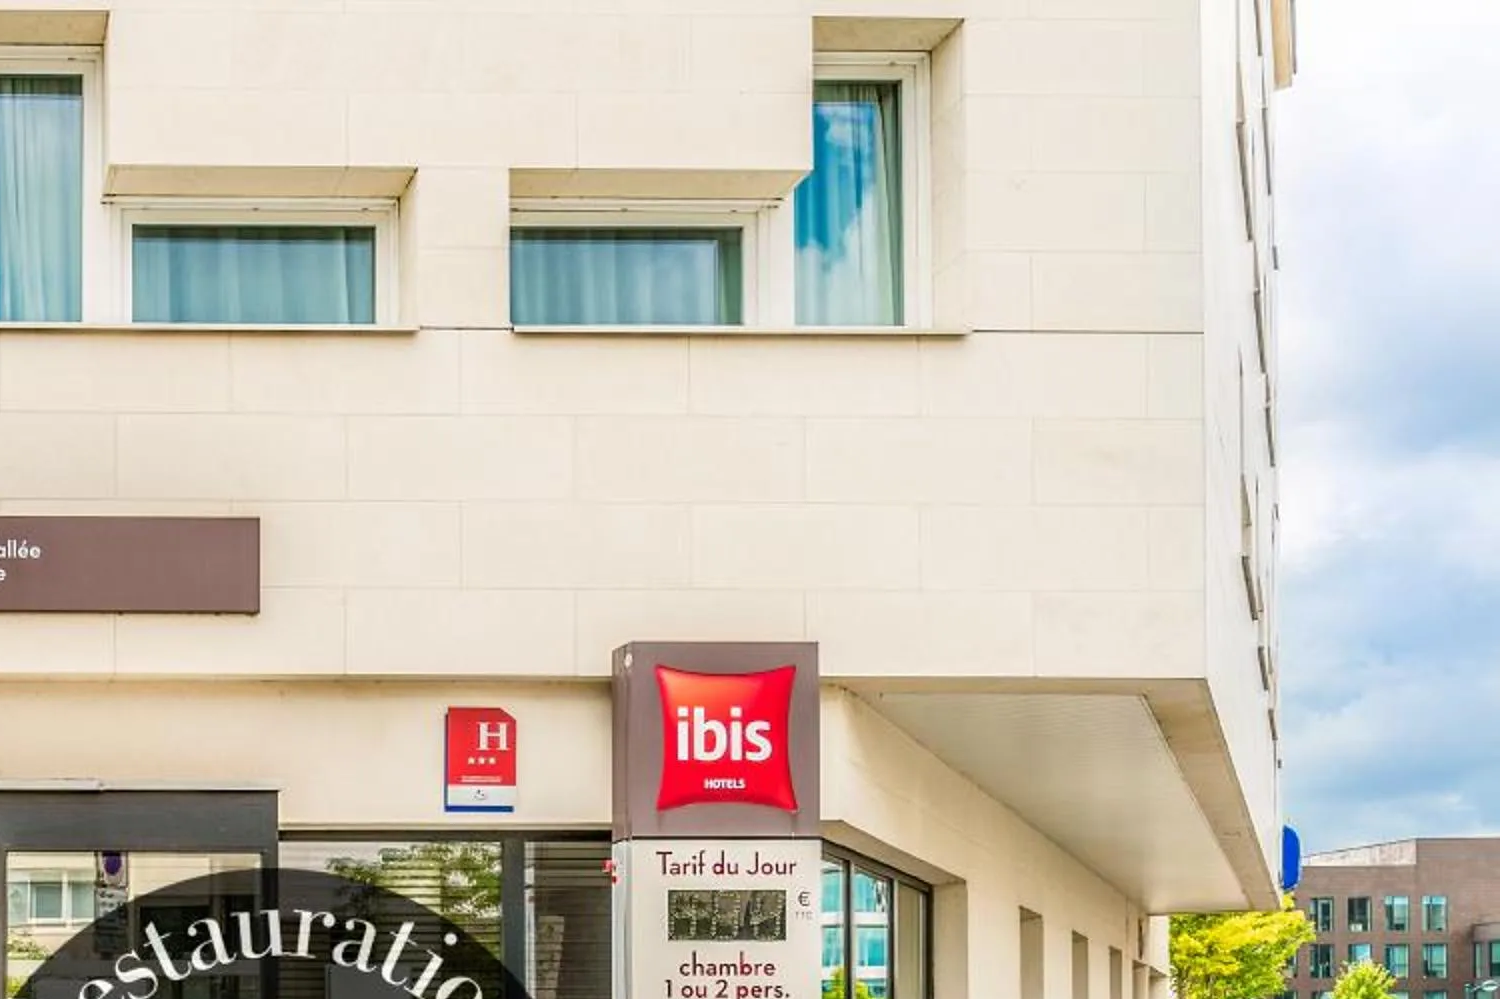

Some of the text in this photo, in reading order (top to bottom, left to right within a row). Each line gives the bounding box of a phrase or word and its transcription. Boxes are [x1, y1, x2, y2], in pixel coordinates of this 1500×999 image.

[476, 721, 511, 751] H
[677, 706, 773, 762] ibis
[704, 777, 746, 790] HOTELS
[656, 850, 797, 876] Tarif du Jour
[679, 951, 776, 976] chambre
[665, 980, 673, 998] 1
[681, 986, 708, 999] ou
[715, 980, 729, 998] 2
